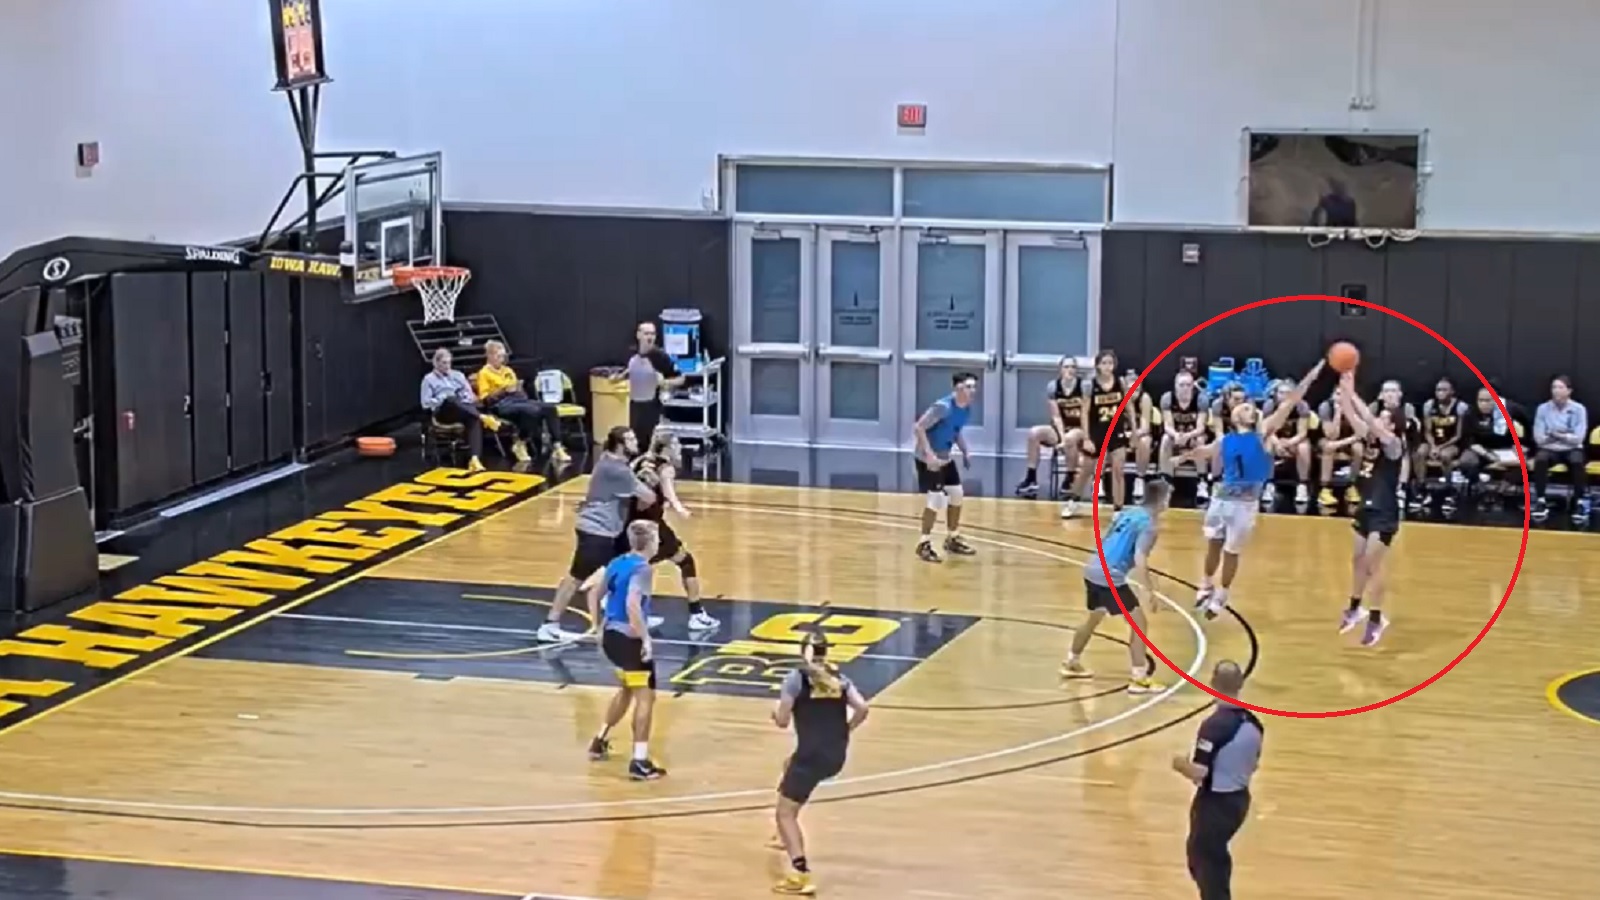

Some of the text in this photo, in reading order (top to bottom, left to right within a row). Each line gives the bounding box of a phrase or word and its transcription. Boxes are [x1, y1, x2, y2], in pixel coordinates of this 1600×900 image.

[185, 246, 240, 264] SPALDING
[270, 256, 305, 272] IOWA
[17, 466, 547, 670] HAWKEYES
